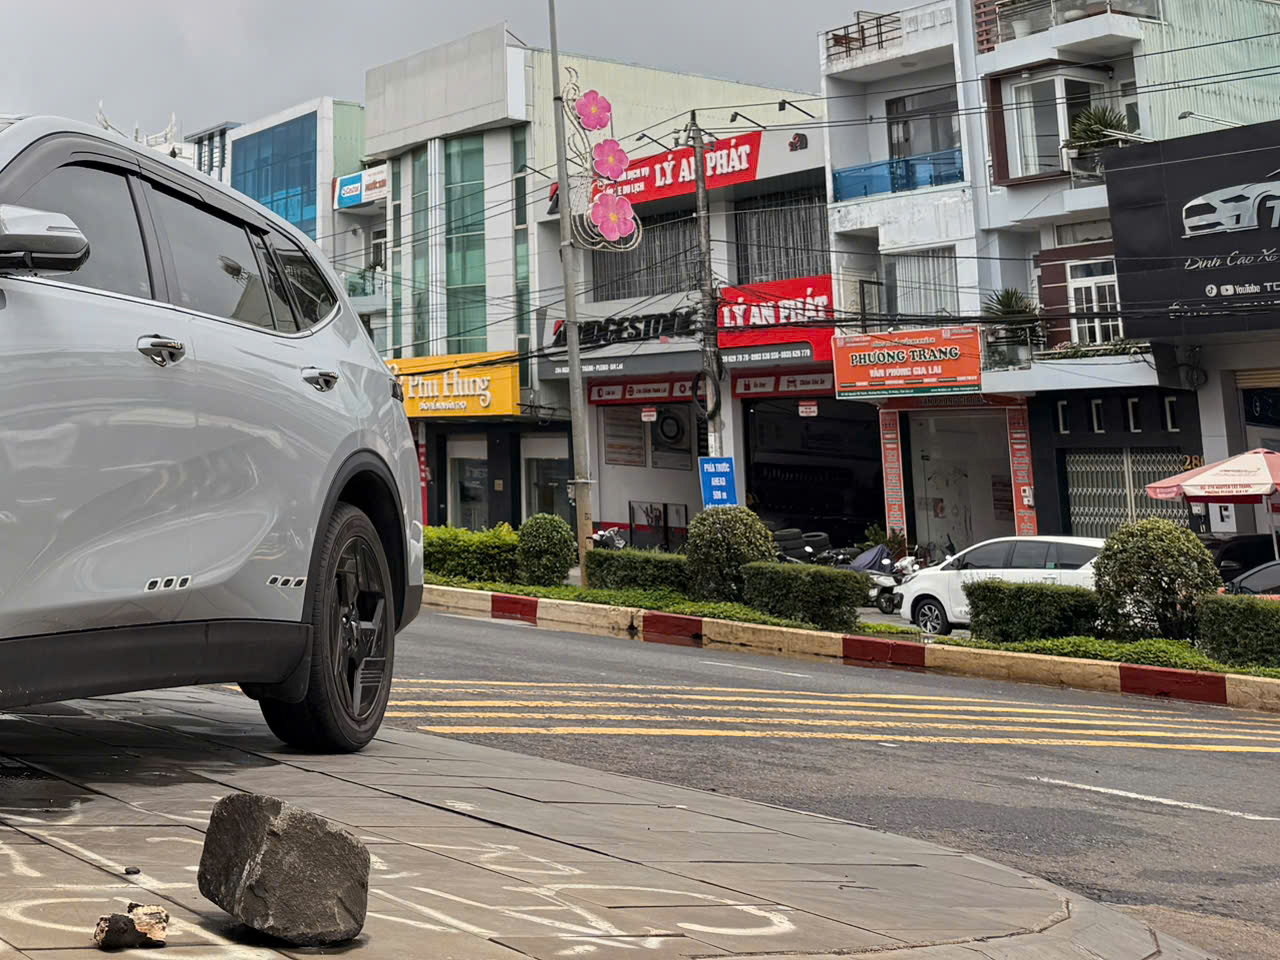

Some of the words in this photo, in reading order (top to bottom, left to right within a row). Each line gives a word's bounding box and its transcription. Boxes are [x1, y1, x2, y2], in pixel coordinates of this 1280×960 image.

[653, 154, 676, 187] LÝ
[705, 139, 751, 176] PHÁT
[749, 300, 776, 326] AN
[909, 346, 961, 362] TRANG
